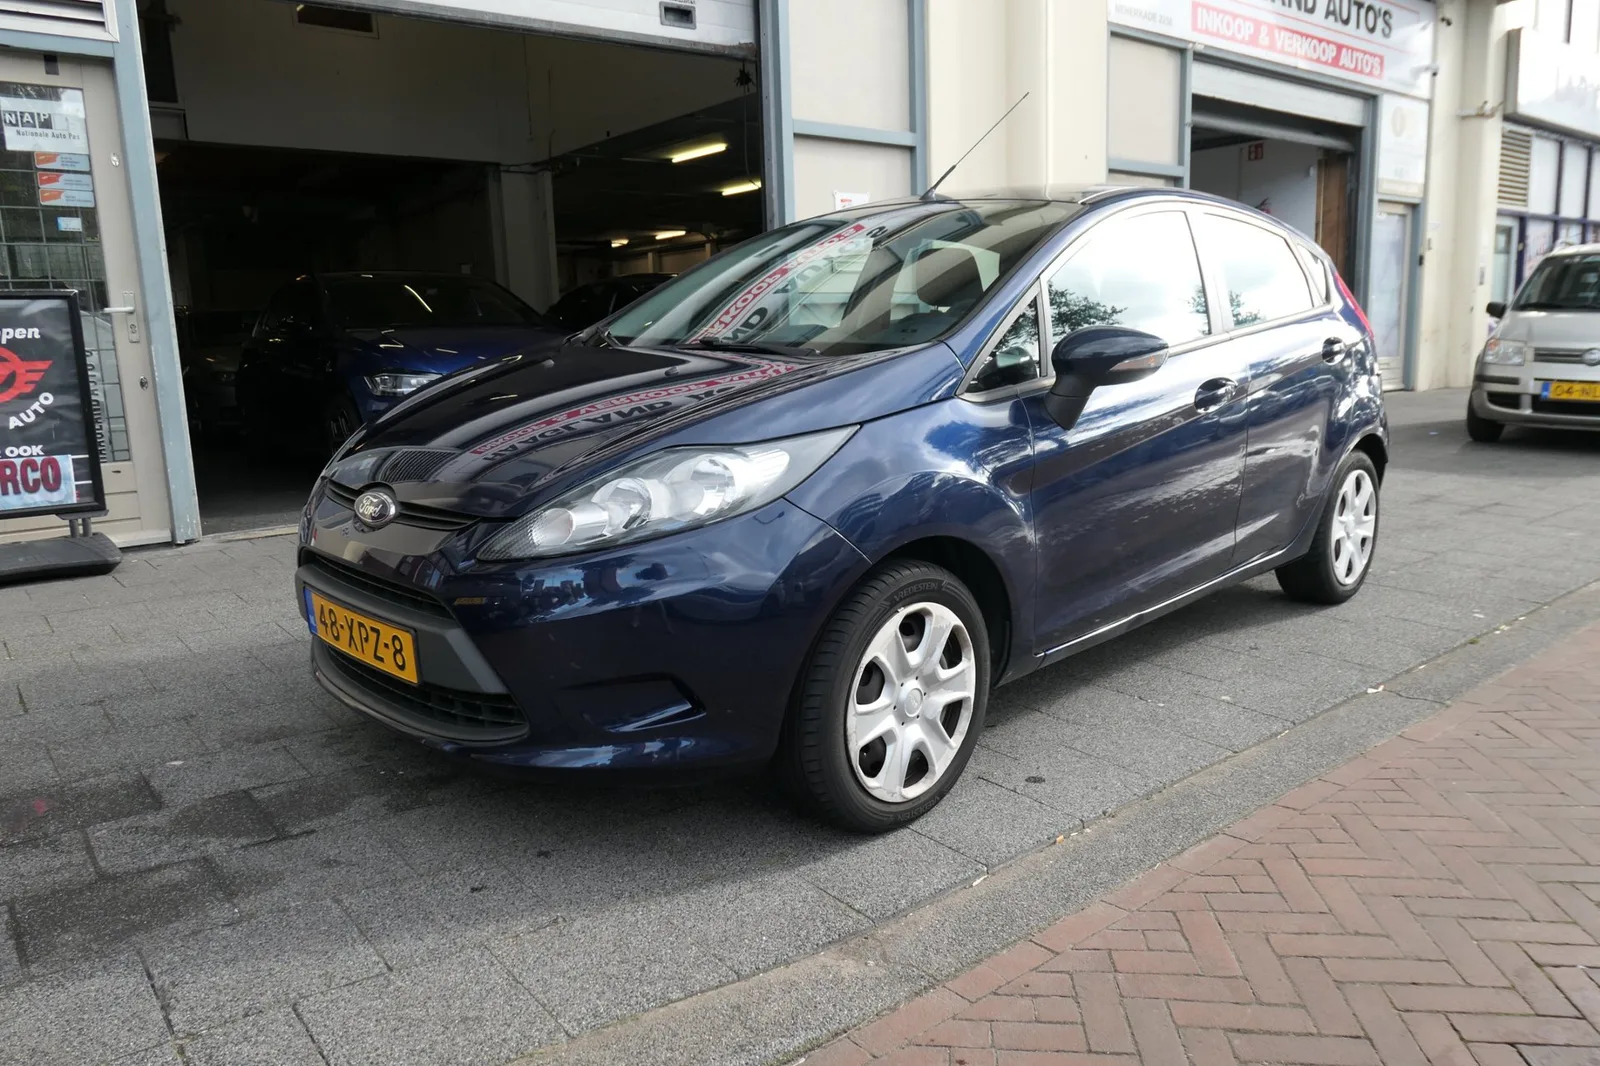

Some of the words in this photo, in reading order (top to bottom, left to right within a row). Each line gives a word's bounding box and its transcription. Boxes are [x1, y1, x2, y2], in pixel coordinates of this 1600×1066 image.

[1324, 0, 1393, 38] AUTO'S
[1197, 7, 1254, 41] INKOOP
[1258, 25, 1270, 45] &
[1274, 28, 1337, 64] VERKOOP
[1339, 46, 1382, 76] AUTO'S
[16, 129, 49, 138] Nationale
[0, 327, 41, 345] pen
[9, 391, 54, 430] AUTO
[5, 444, 45, 458] OOK
[359, 495, 383, 518] Ford
[319, 602, 406, 673] 48-XPZ-8
